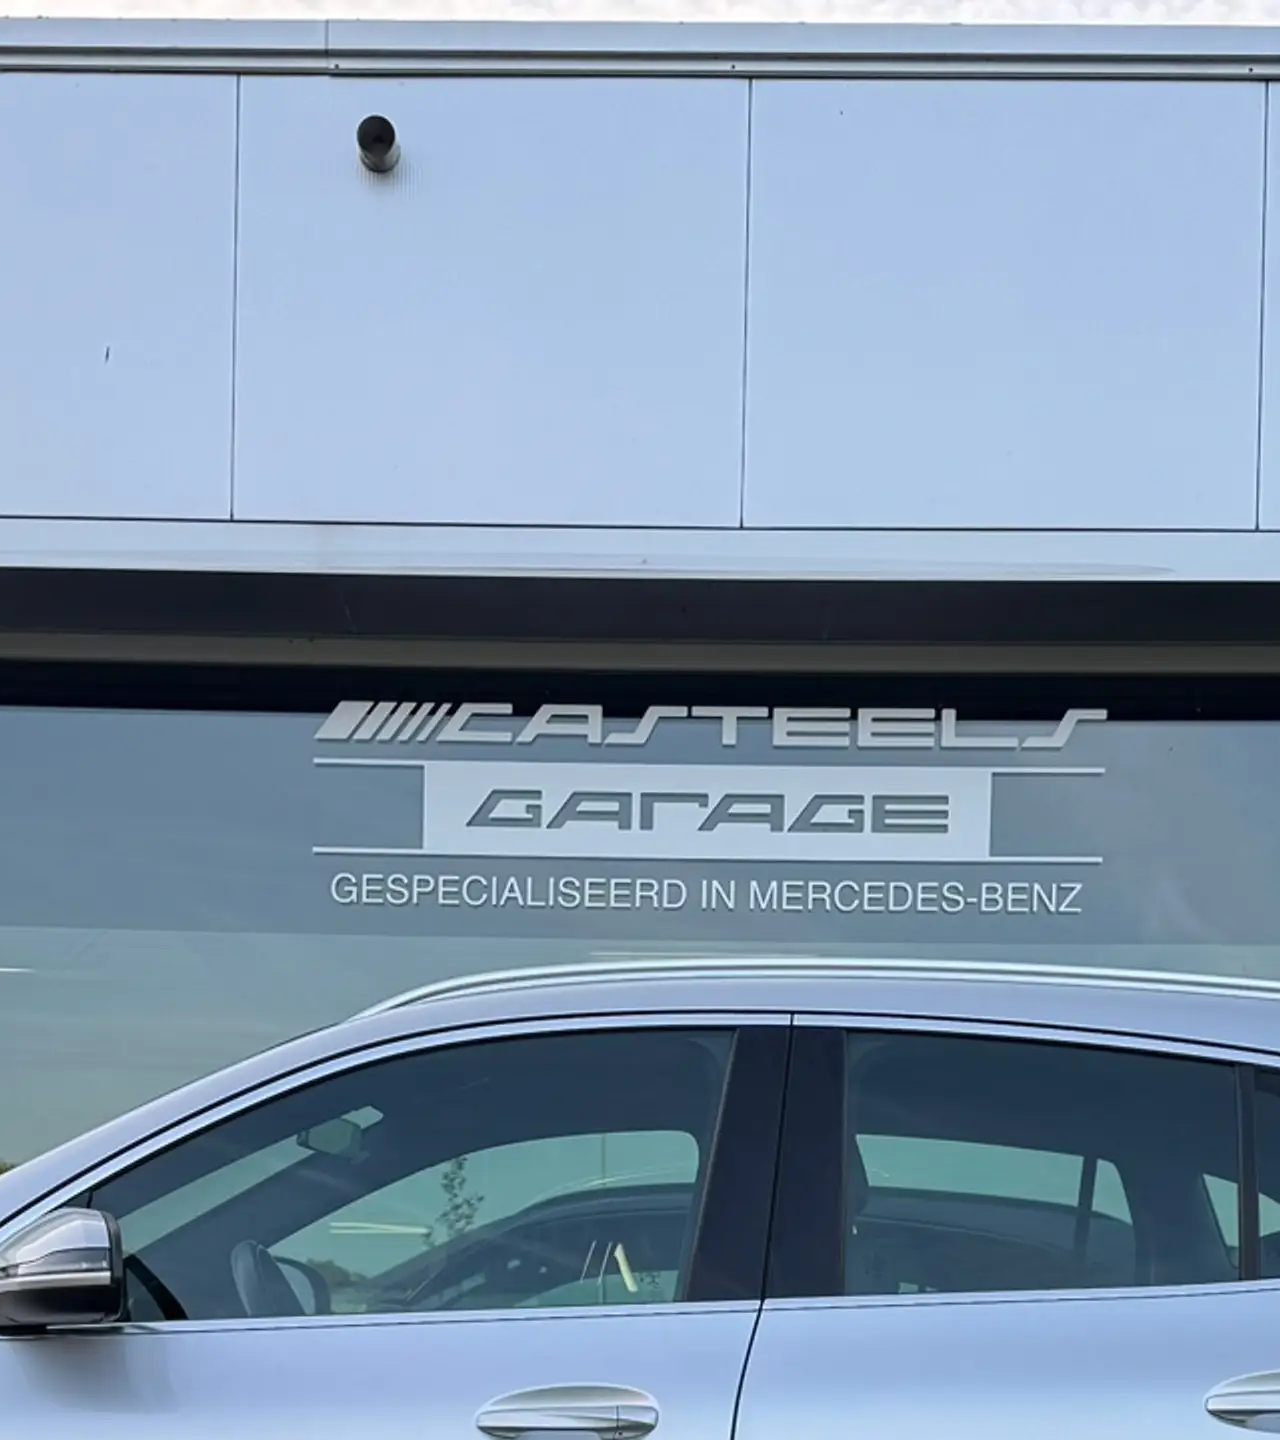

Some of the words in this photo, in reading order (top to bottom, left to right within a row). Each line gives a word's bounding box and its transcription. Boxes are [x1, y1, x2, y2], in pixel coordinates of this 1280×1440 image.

[436, 701, 1108, 751] CASTEELS
[465, 788, 950, 834] GARAGE
[330, 871, 689, 910] GESPECIALISEERD
[699, 879, 736, 911] IN
[747, 879, 1084, 915] MERCEDES-BENZ
